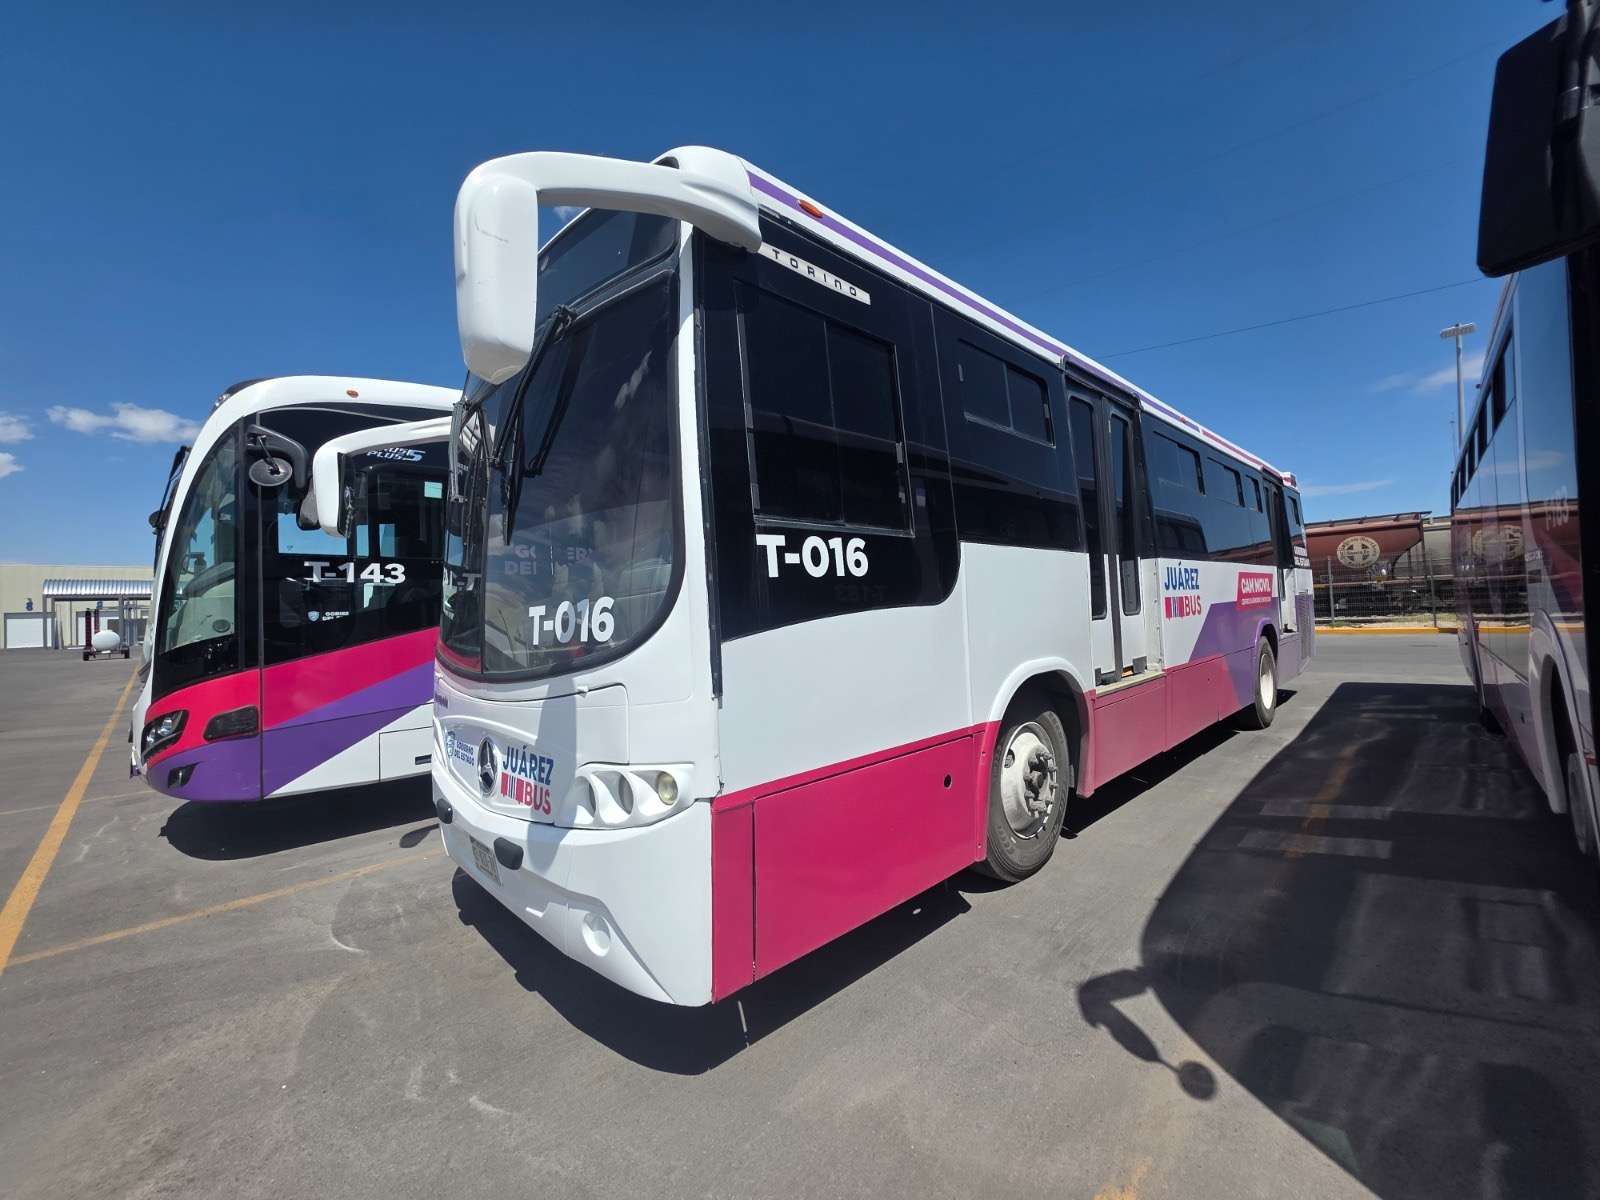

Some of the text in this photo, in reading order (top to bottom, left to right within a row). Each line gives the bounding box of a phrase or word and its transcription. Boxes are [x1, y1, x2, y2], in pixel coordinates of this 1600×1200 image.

[772, 249, 857, 296] TORINO
[303, 561, 406, 584] T-143
[756, 534, 869, 578] T-016
[1164, 561, 1200, 590] JUÁREZ
[528, 596, 615, 645] T-016
[1184, 595, 1201, 616] BUS
[502, 744, 554, 786] JUÁREZ
[524, 781, 552, 815] BUS
